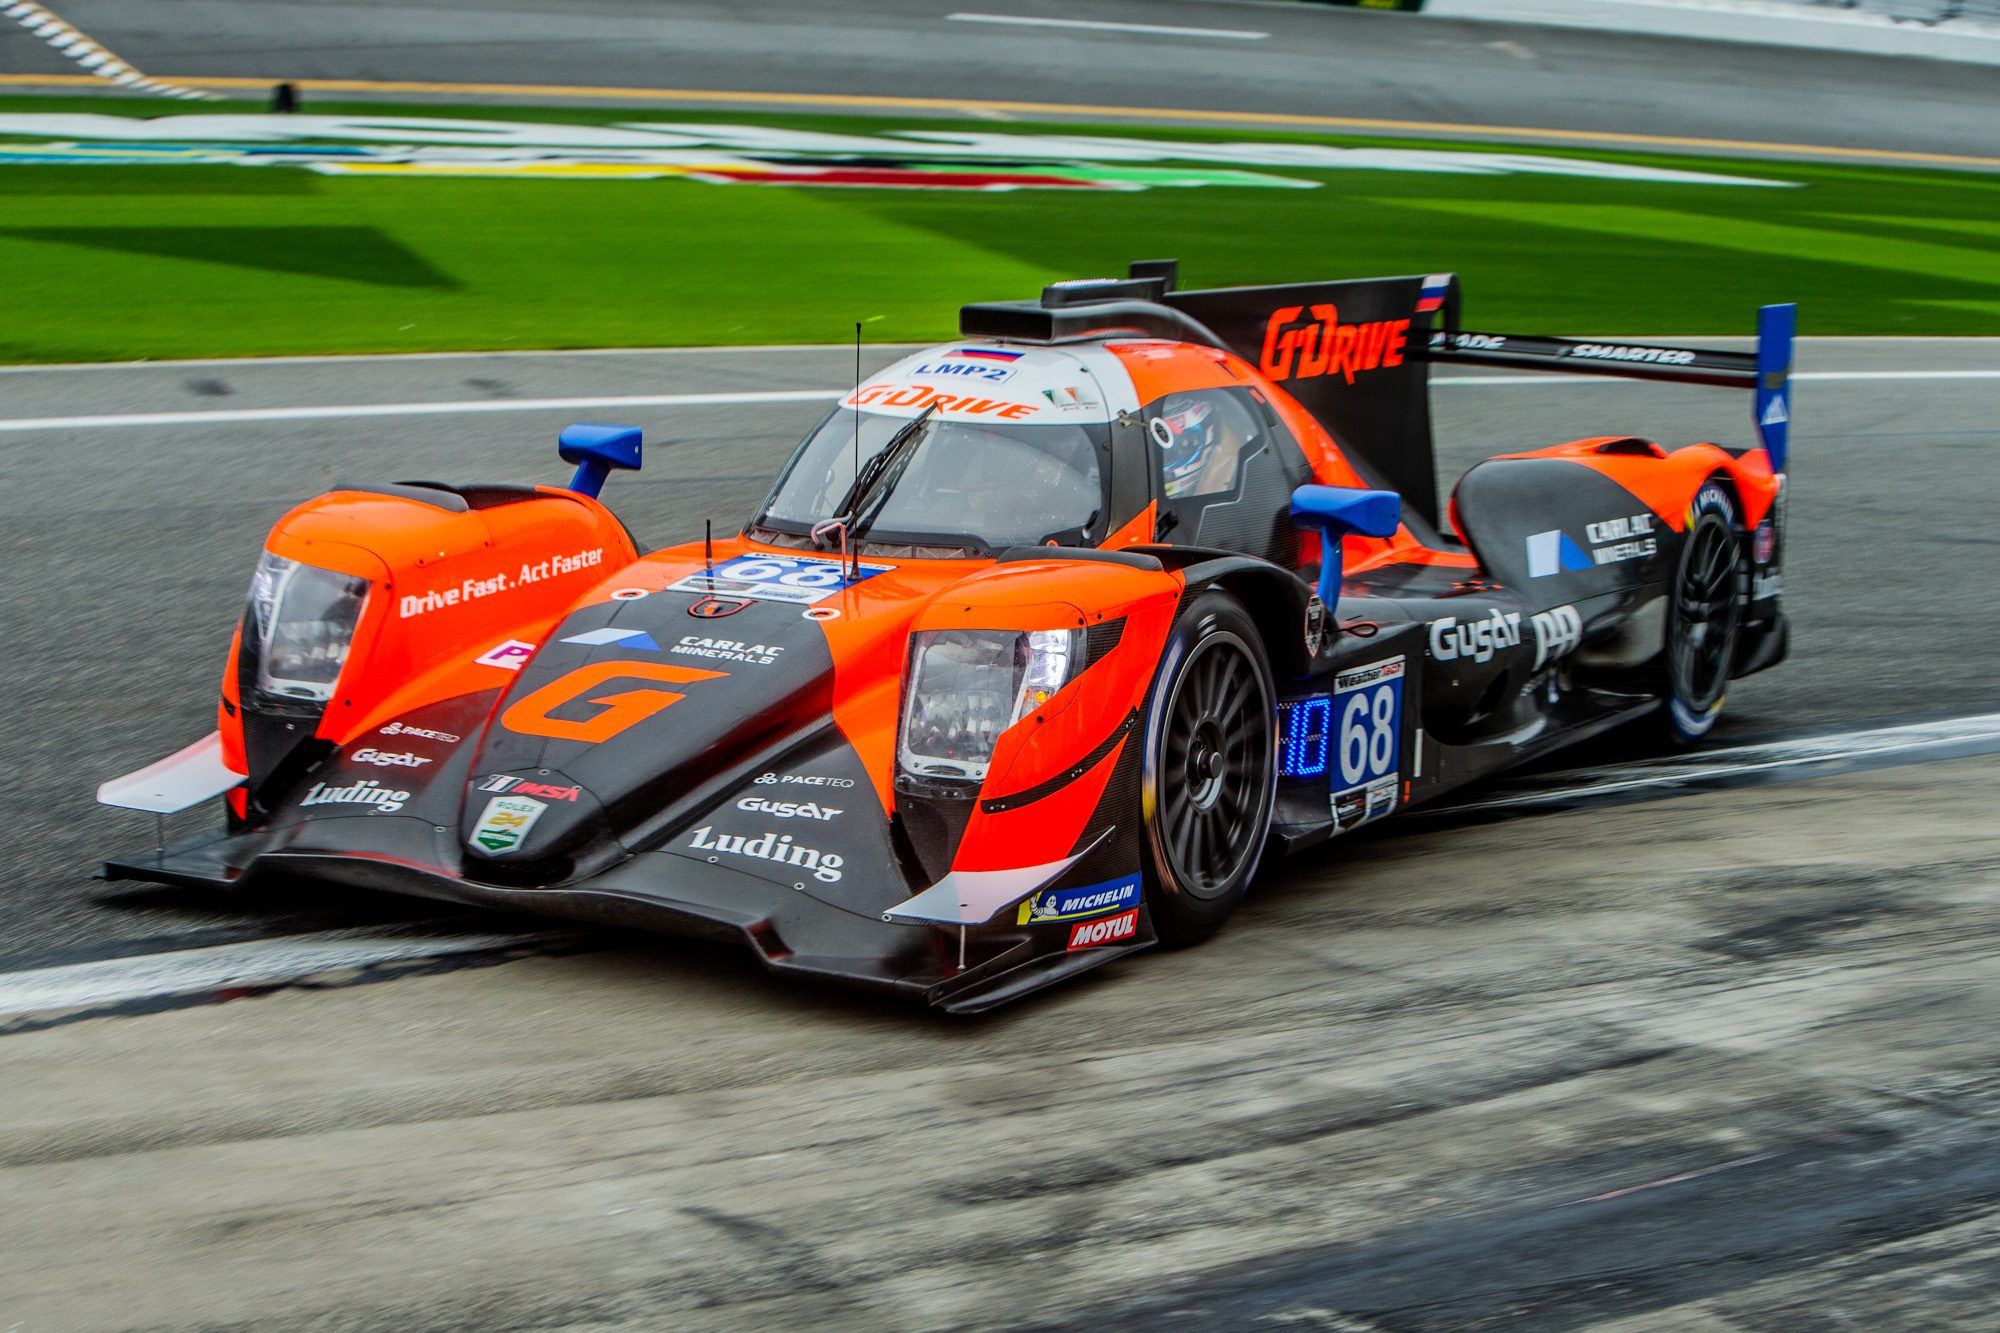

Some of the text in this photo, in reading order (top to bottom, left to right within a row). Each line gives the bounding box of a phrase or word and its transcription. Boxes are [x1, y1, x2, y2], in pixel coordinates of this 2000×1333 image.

[1570, 344, 1696, 364] SMARTER
[915, 363, 1007, 381] LMP2
[1585, 513, 1656, 544] CARLAC
[400, 588, 460, 619] Drive
[462, 573, 507, 601] Fast
[518, 562, 549, 586] Act
[552, 548, 603, 576] Faster
[720, 558, 851, 588] 68
[670, 645, 775, 665] MINERALS
[680, 636, 785, 656] CARLAC
[500, 660, 732, 743] G
[1339, 685, 1395, 785] 68
[299, 780, 411, 812] Luding
[511, 782, 580, 802] IMSA
[780, 775, 855, 788] PACETEQ
[487, 812, 530, 828] 24
[688, 826, 844, 883] Luding
[1061, 884, 1135, 912] MICHELIN
[1071, 914, 1134, 947] MOTUL
